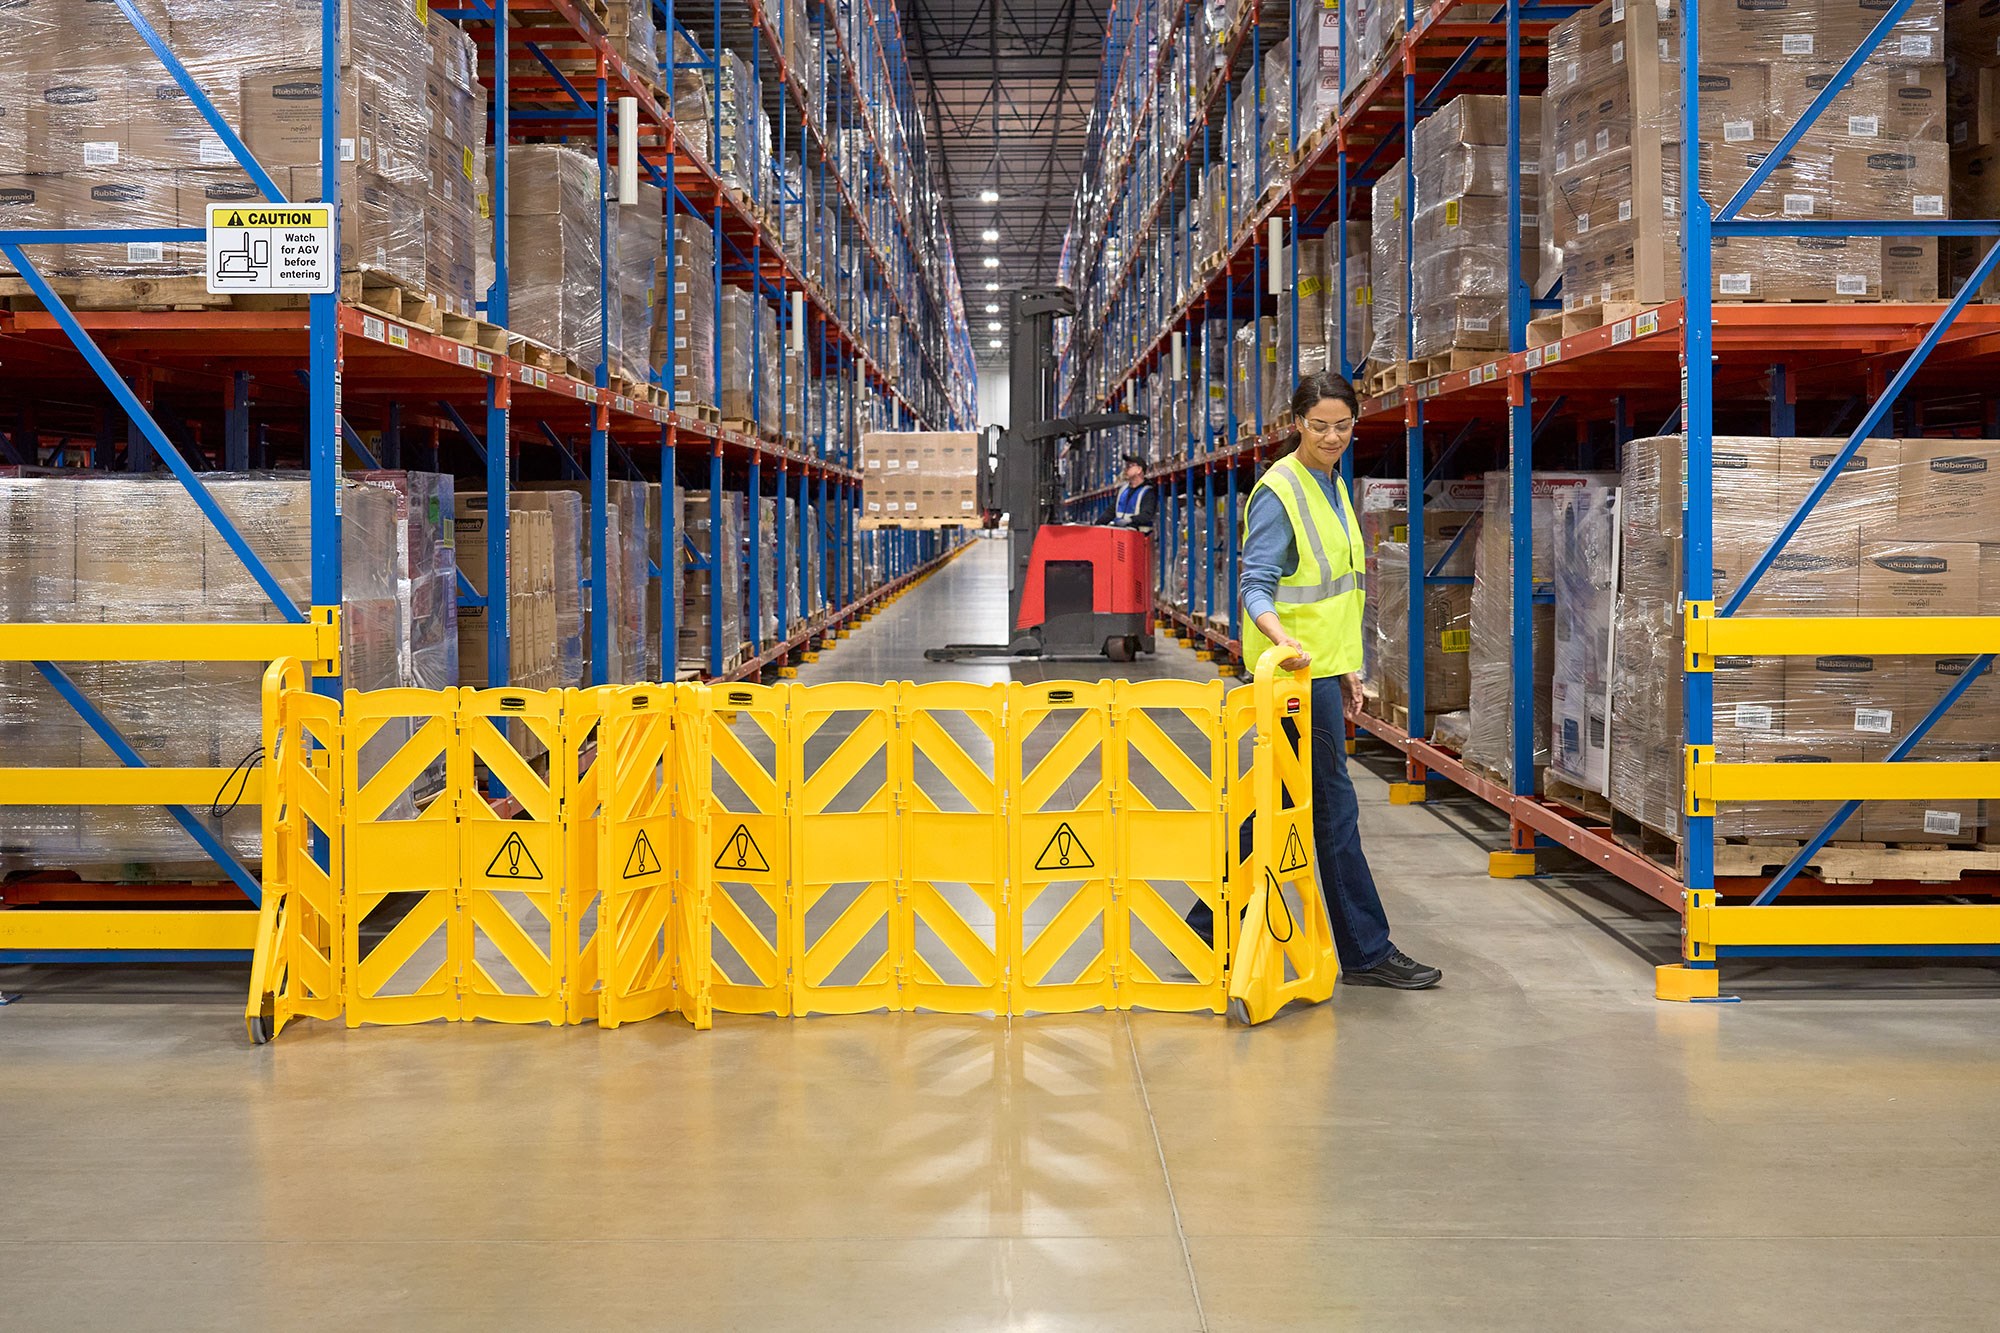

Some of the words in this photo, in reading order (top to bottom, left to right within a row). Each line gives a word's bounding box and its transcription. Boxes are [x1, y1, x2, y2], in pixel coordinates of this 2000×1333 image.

[248, 213, 311, 225] CAUTION
[285, 233, 315, 242] Watch
[281, 245, 295, 254] for
[298, 245, 319, 254] AGV
[284, 257, 316, 266] before
[279, 270, 321, 280] entering
[1932, 461, 1985, 469] Rubbermaid
[1818, 660, 1871, 668] Rubbermaid
